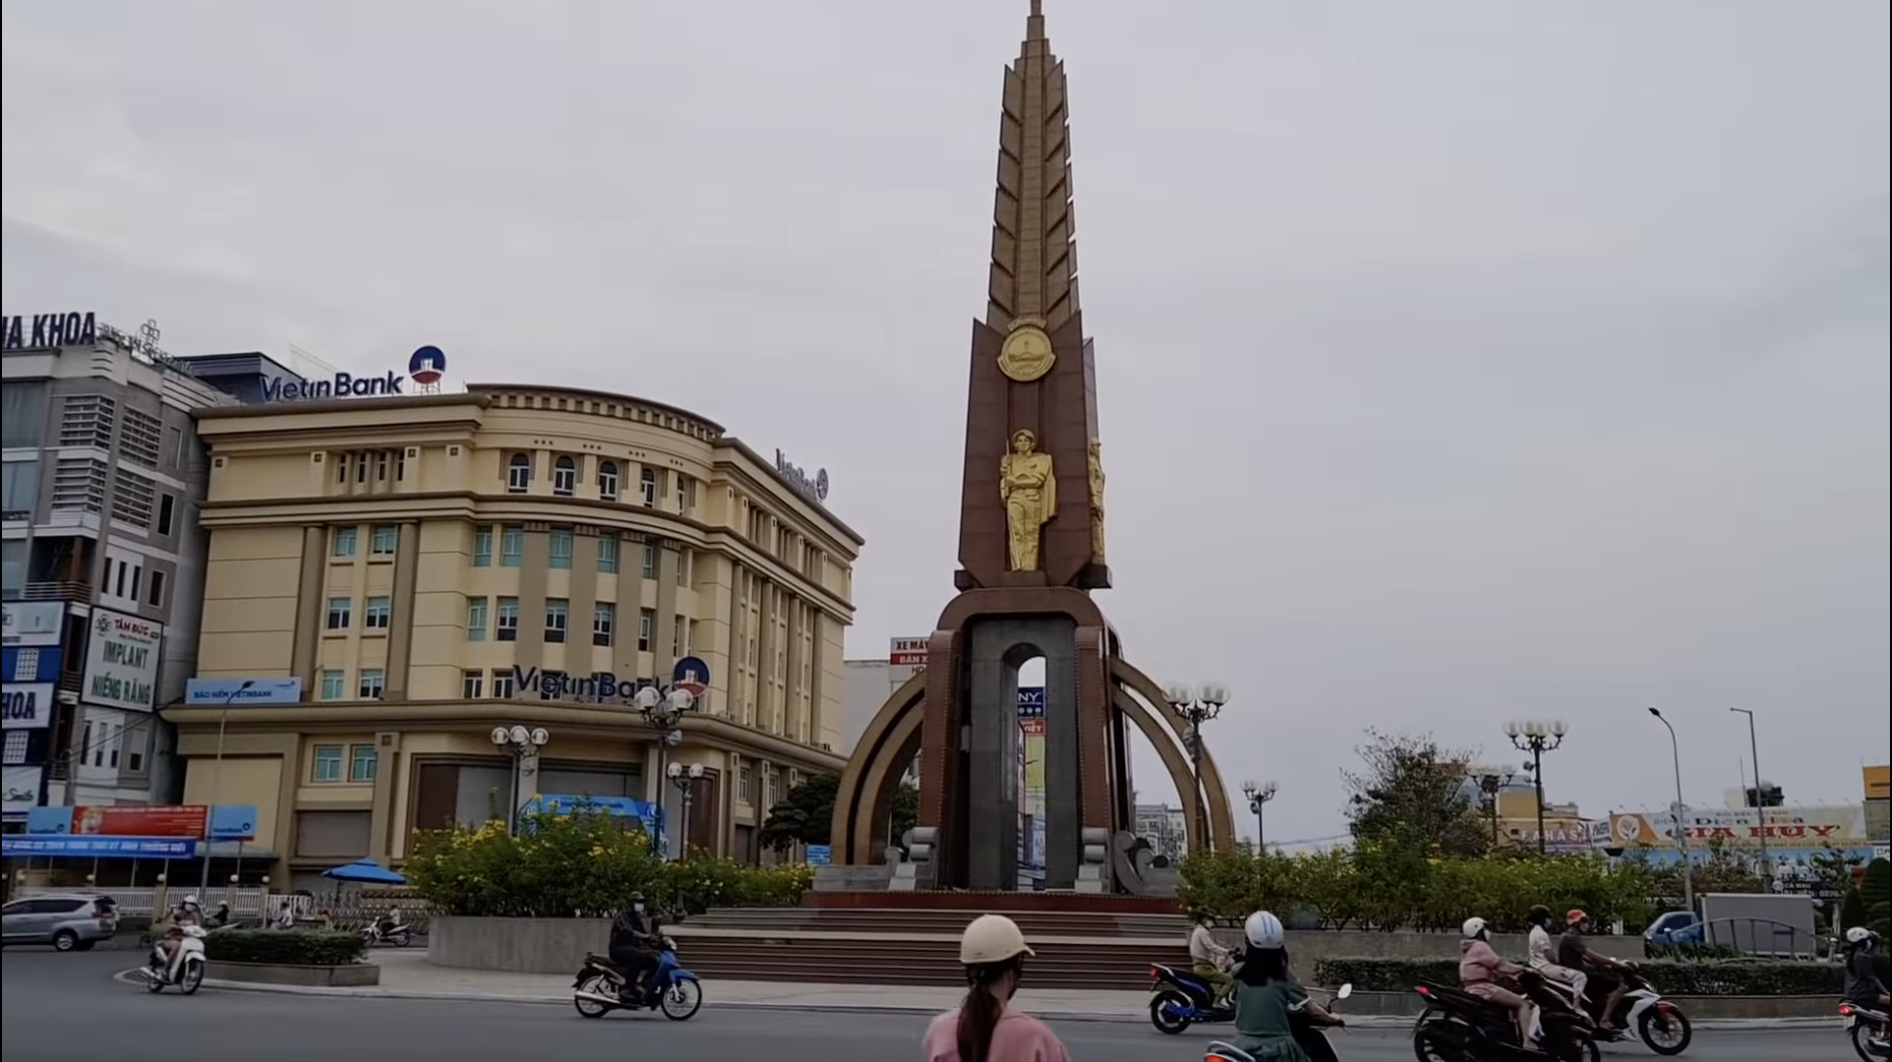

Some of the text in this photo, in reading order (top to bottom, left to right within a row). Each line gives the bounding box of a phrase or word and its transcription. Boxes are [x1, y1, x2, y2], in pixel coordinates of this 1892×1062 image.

[31, 311, 95, 347] KHOA
[103, 640, 150, 669] IMPLANT
[896, 640, 908, 650] XE
[1749, 825, 1837, 839] HUY
